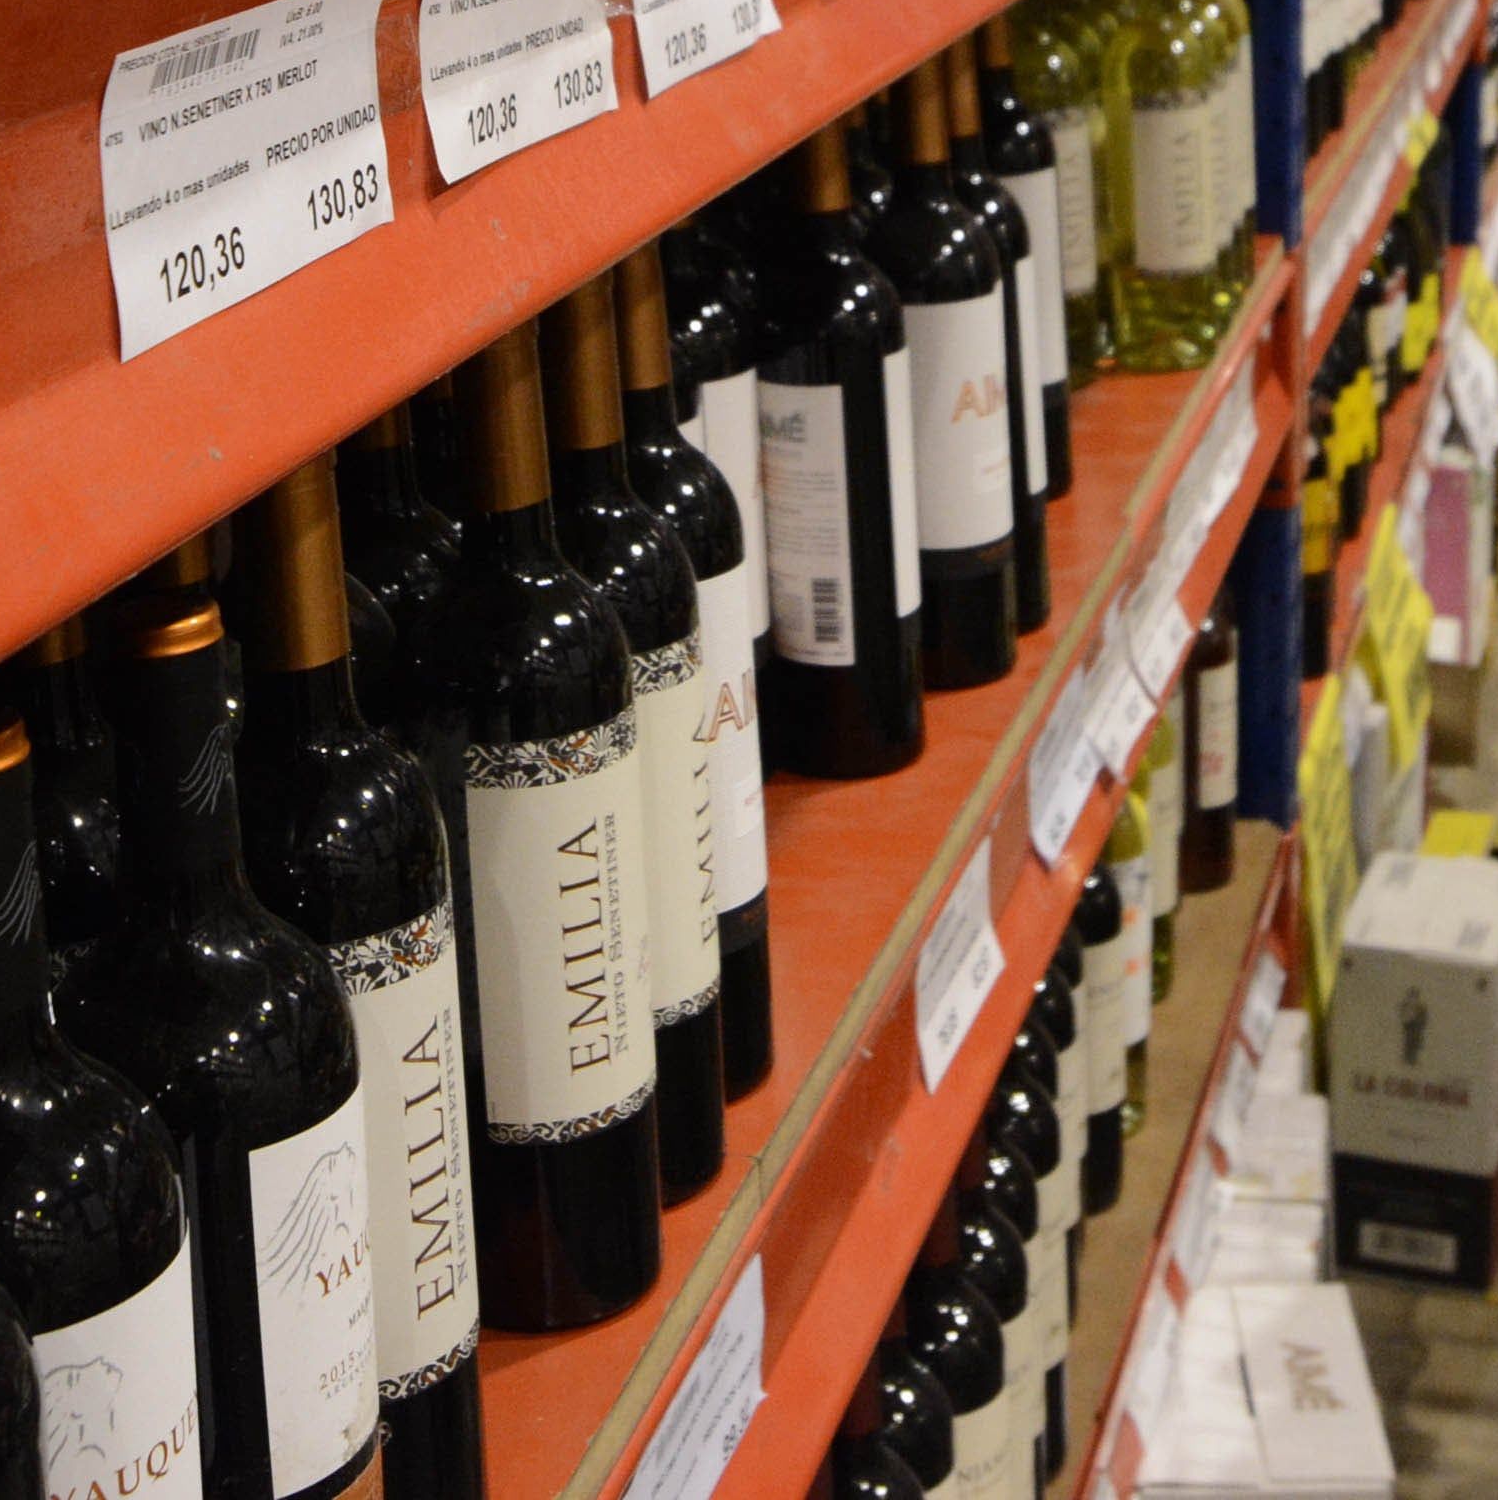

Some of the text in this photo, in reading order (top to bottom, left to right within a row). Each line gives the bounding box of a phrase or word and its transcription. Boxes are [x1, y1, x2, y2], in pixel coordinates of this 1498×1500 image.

[479, 50, 495, 64] mas
[525, 27, 555, 53] PRECIO
[556, 17, 584, 41] UNIDAD
[665, 23, 707, 68] 120,36
[138, 117, 168, 143] VINO
[170, 89, 244, 134] N.SENETINER
[245, 88, 253, 102] X
[255, 77, 273, 97] 750
[277, 59, 319, 90] MERLOT
[467, 60, 604, 147] 120,36 130,83
[109, 103, 377, 231] LLevando 4 o mas unidades PRECIO POR UNIDAD
[159, 163, 379, 303] 120,36 130,83
[557, 816, 612, 1077] EMILIA
[612, 971, 629, 1056] NIETO
[402, 1015, 456, 1320] EMILIA
[319, 1350, 355, 1391] 2015
